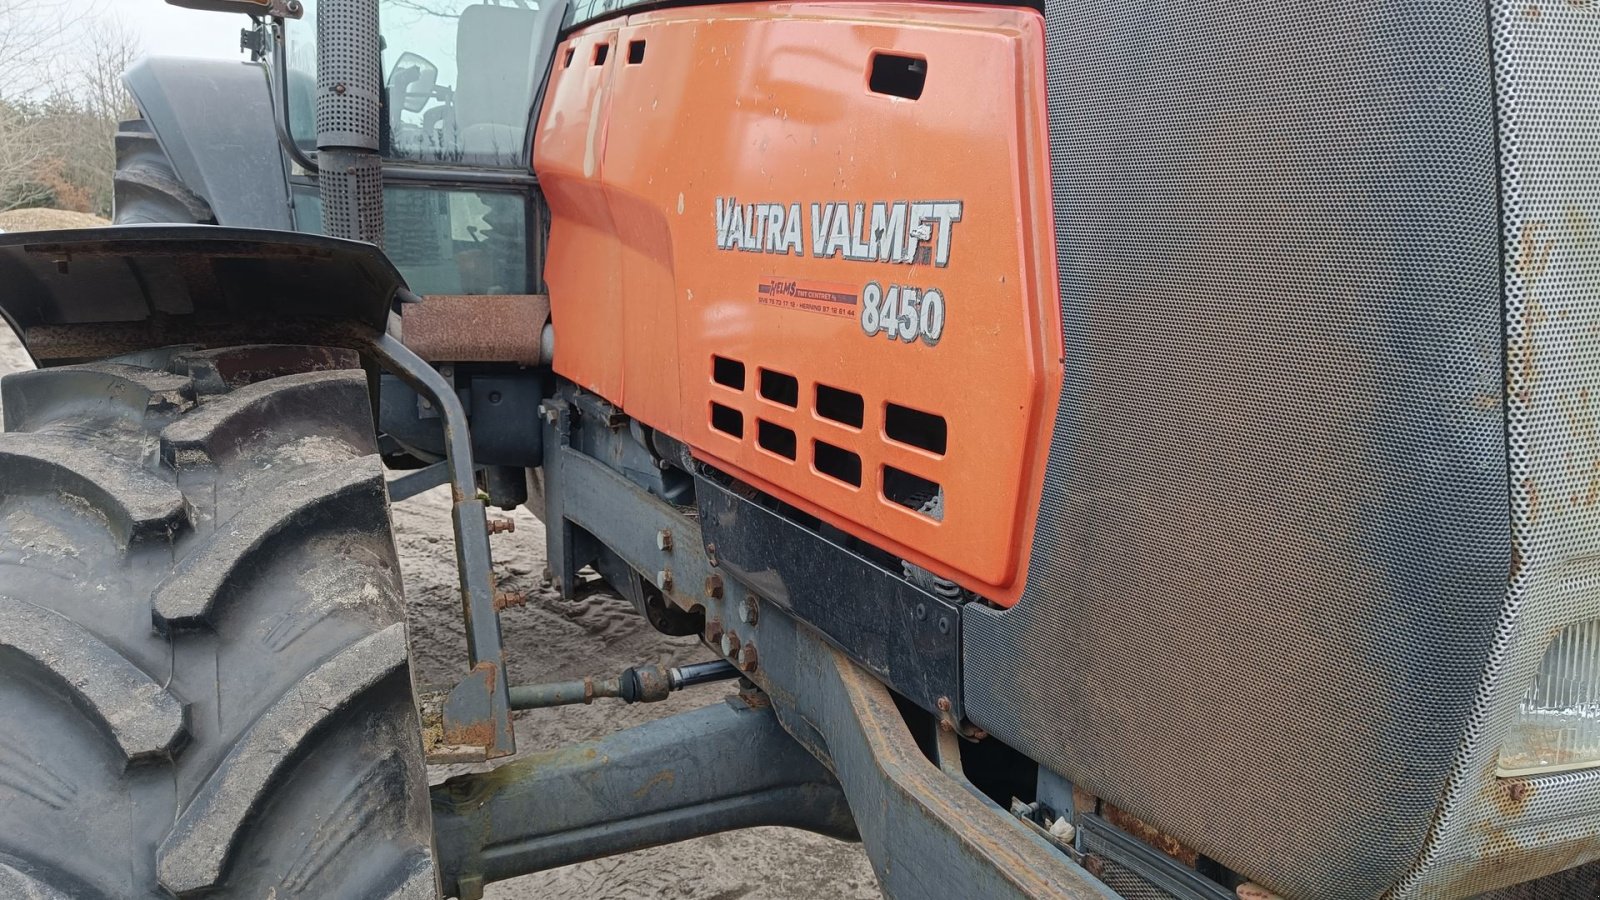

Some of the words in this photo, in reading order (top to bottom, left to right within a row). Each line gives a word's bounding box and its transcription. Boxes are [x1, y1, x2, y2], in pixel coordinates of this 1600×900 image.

[715, 196, 804, 256] VALTRA
[769, 280, 797, 297] HELMS
[860, 279, 946, 347] 8450
